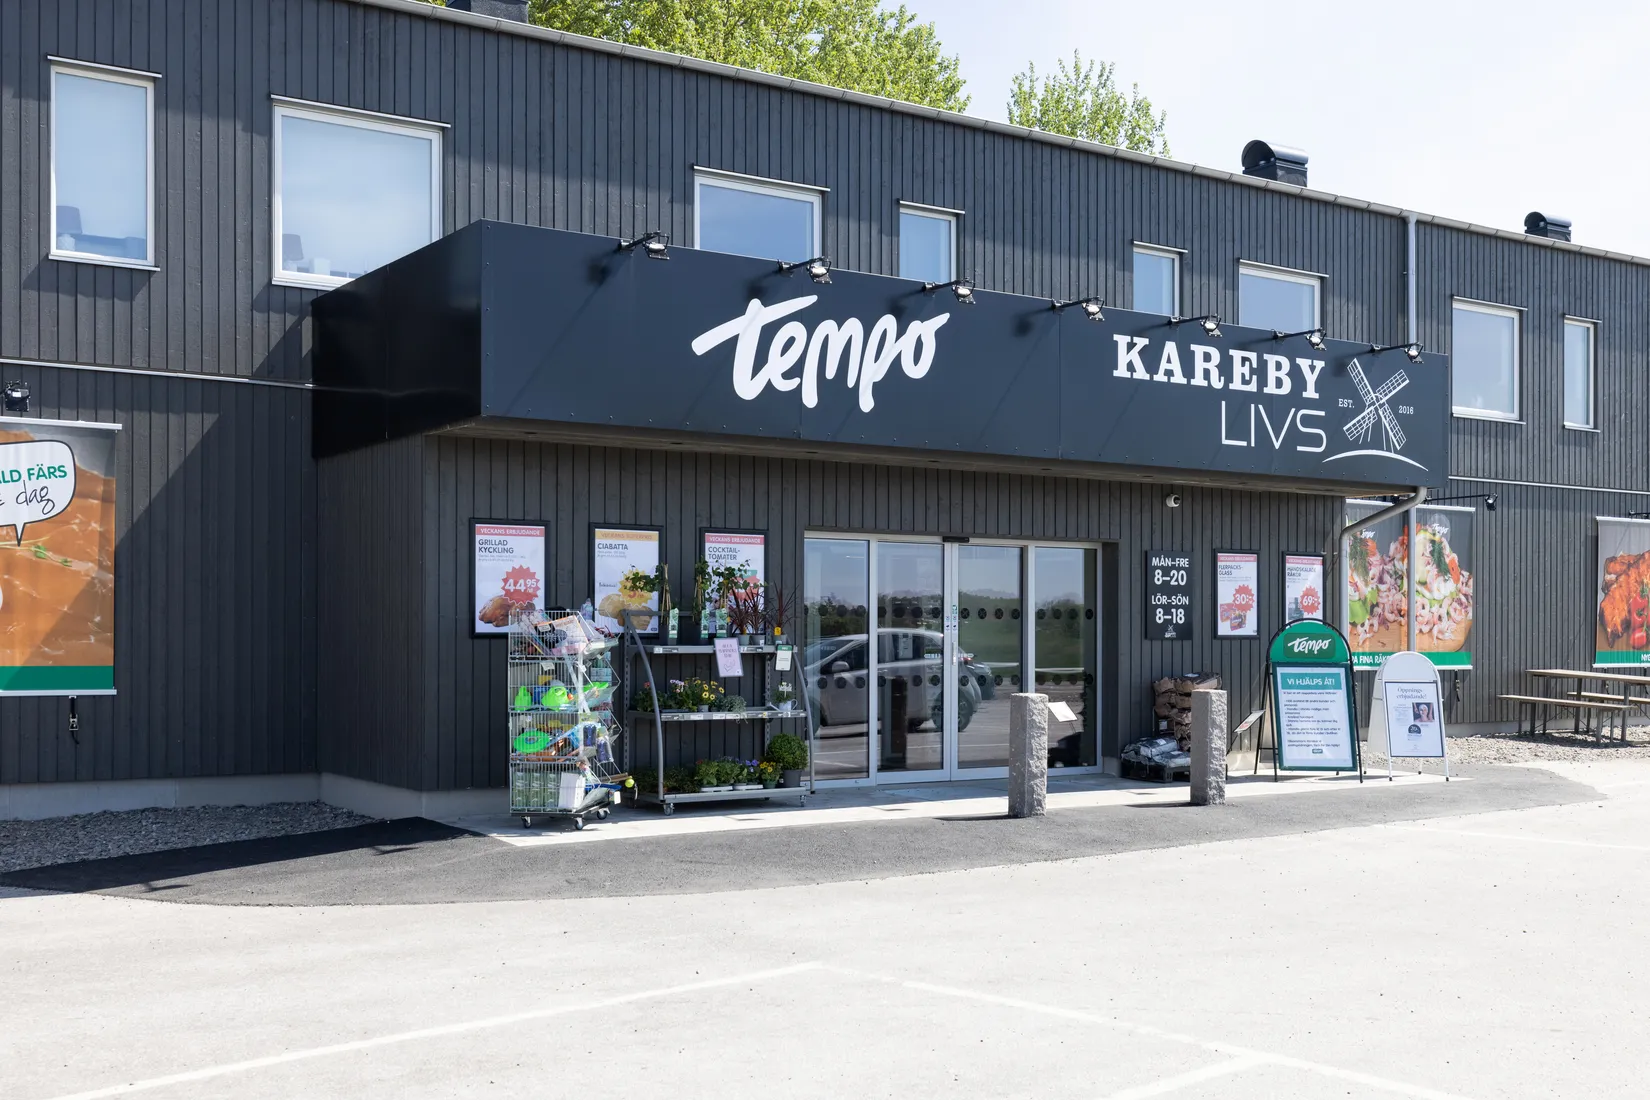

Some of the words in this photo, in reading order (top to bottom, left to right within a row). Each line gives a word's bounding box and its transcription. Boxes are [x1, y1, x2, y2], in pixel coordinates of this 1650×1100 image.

[1112, 333, 1326, 399] KAREBY
[1338, 398, 1355, 409] EST.
[1398, 405, 1414, 415] 2016
[1221, 400, 1327, 453] LIVS
[27, 463, 68, 481] FÄRS
[16, 479, 56, 515] dag
[478, 538, 508, 546] GRILLAD
[597, 542, 628, 550] CIABATTA
[478, 546, 514, 554] KYCKLING
[708, 546, 741, 554] COCKTAIL-
[708, 553, 737, 561] TOMATER
[1360, 655, 1374, 664] FINA
[1296, 676, 1323, 686] HJÄLPS
[1324, 676, 1335, 686] ÅT!
